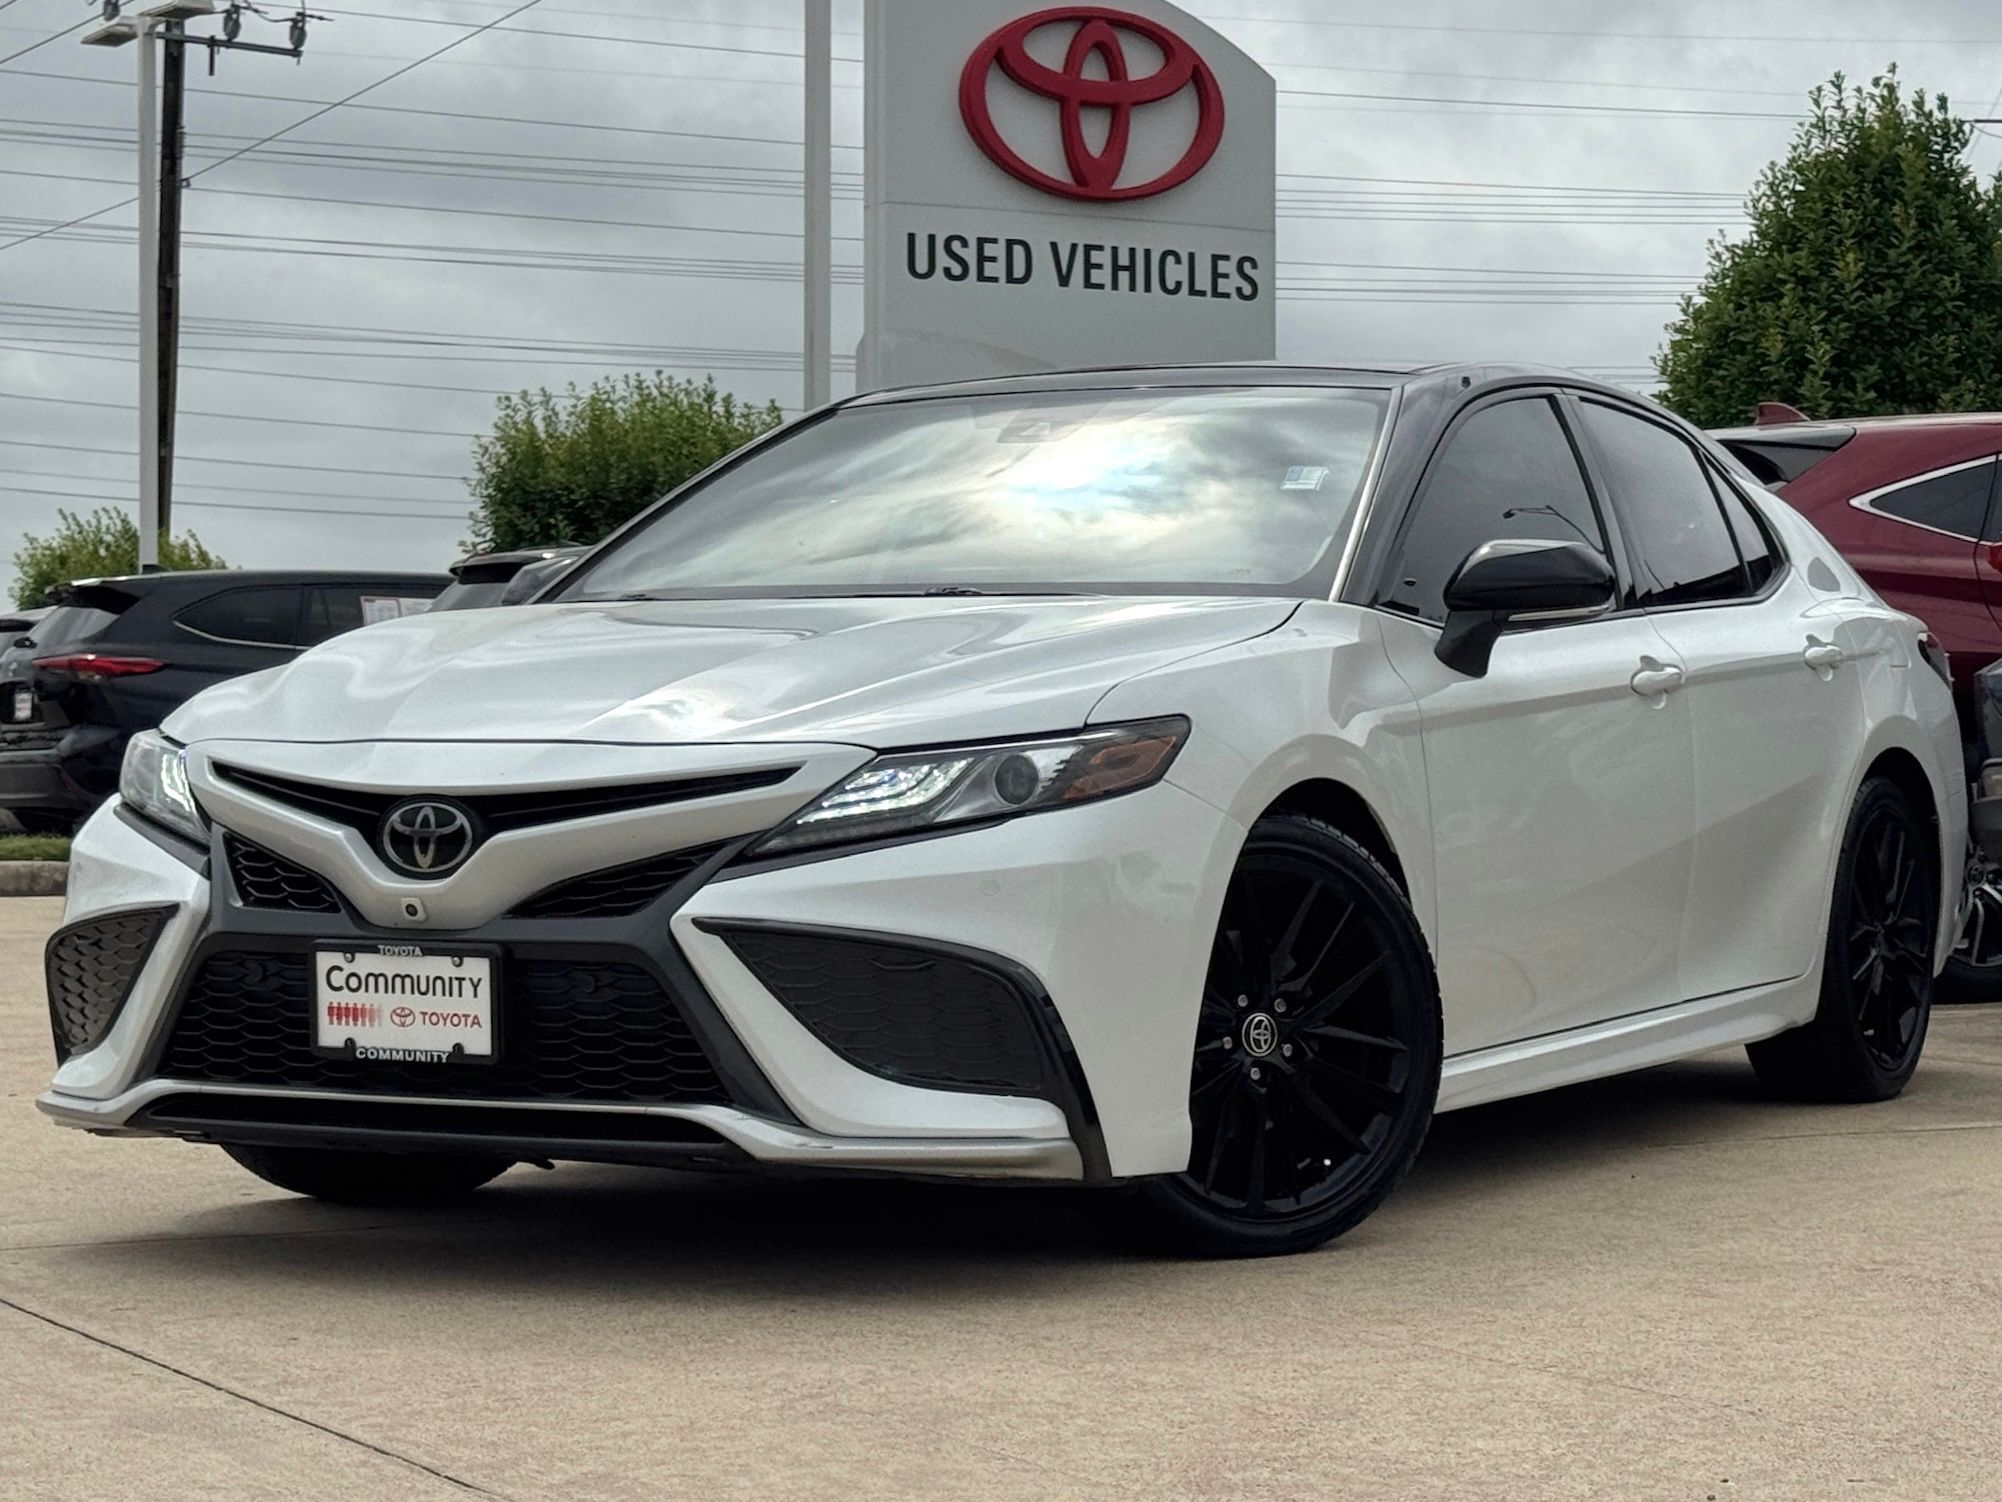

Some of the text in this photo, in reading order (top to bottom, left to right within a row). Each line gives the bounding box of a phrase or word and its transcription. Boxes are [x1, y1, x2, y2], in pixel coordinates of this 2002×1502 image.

[906, 232, 1259, 302] USED VEHICLES
[377, 945, 423, 957] TOYOTA
[419, 1011, 482, 1028] TOYOTA
[355, 1047, 450, 1063] COMMUNITY
